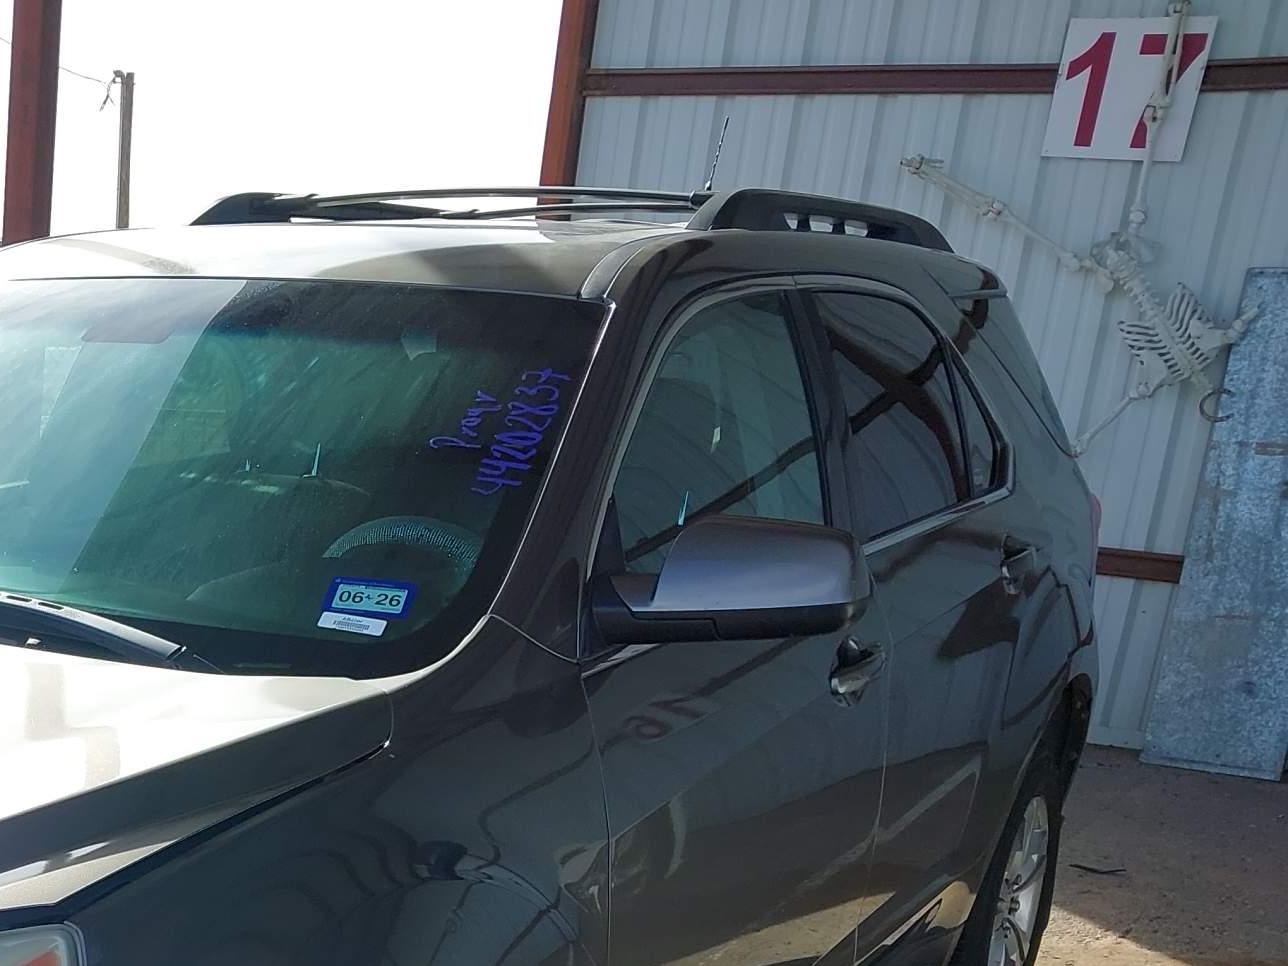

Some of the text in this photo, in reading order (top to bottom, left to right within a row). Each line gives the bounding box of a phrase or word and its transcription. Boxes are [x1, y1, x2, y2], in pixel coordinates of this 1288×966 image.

[1065, 31, 1209, 149] 17
[470, 368, 572, 496] 44202837
[338, 590, 402, 608] 06 26
